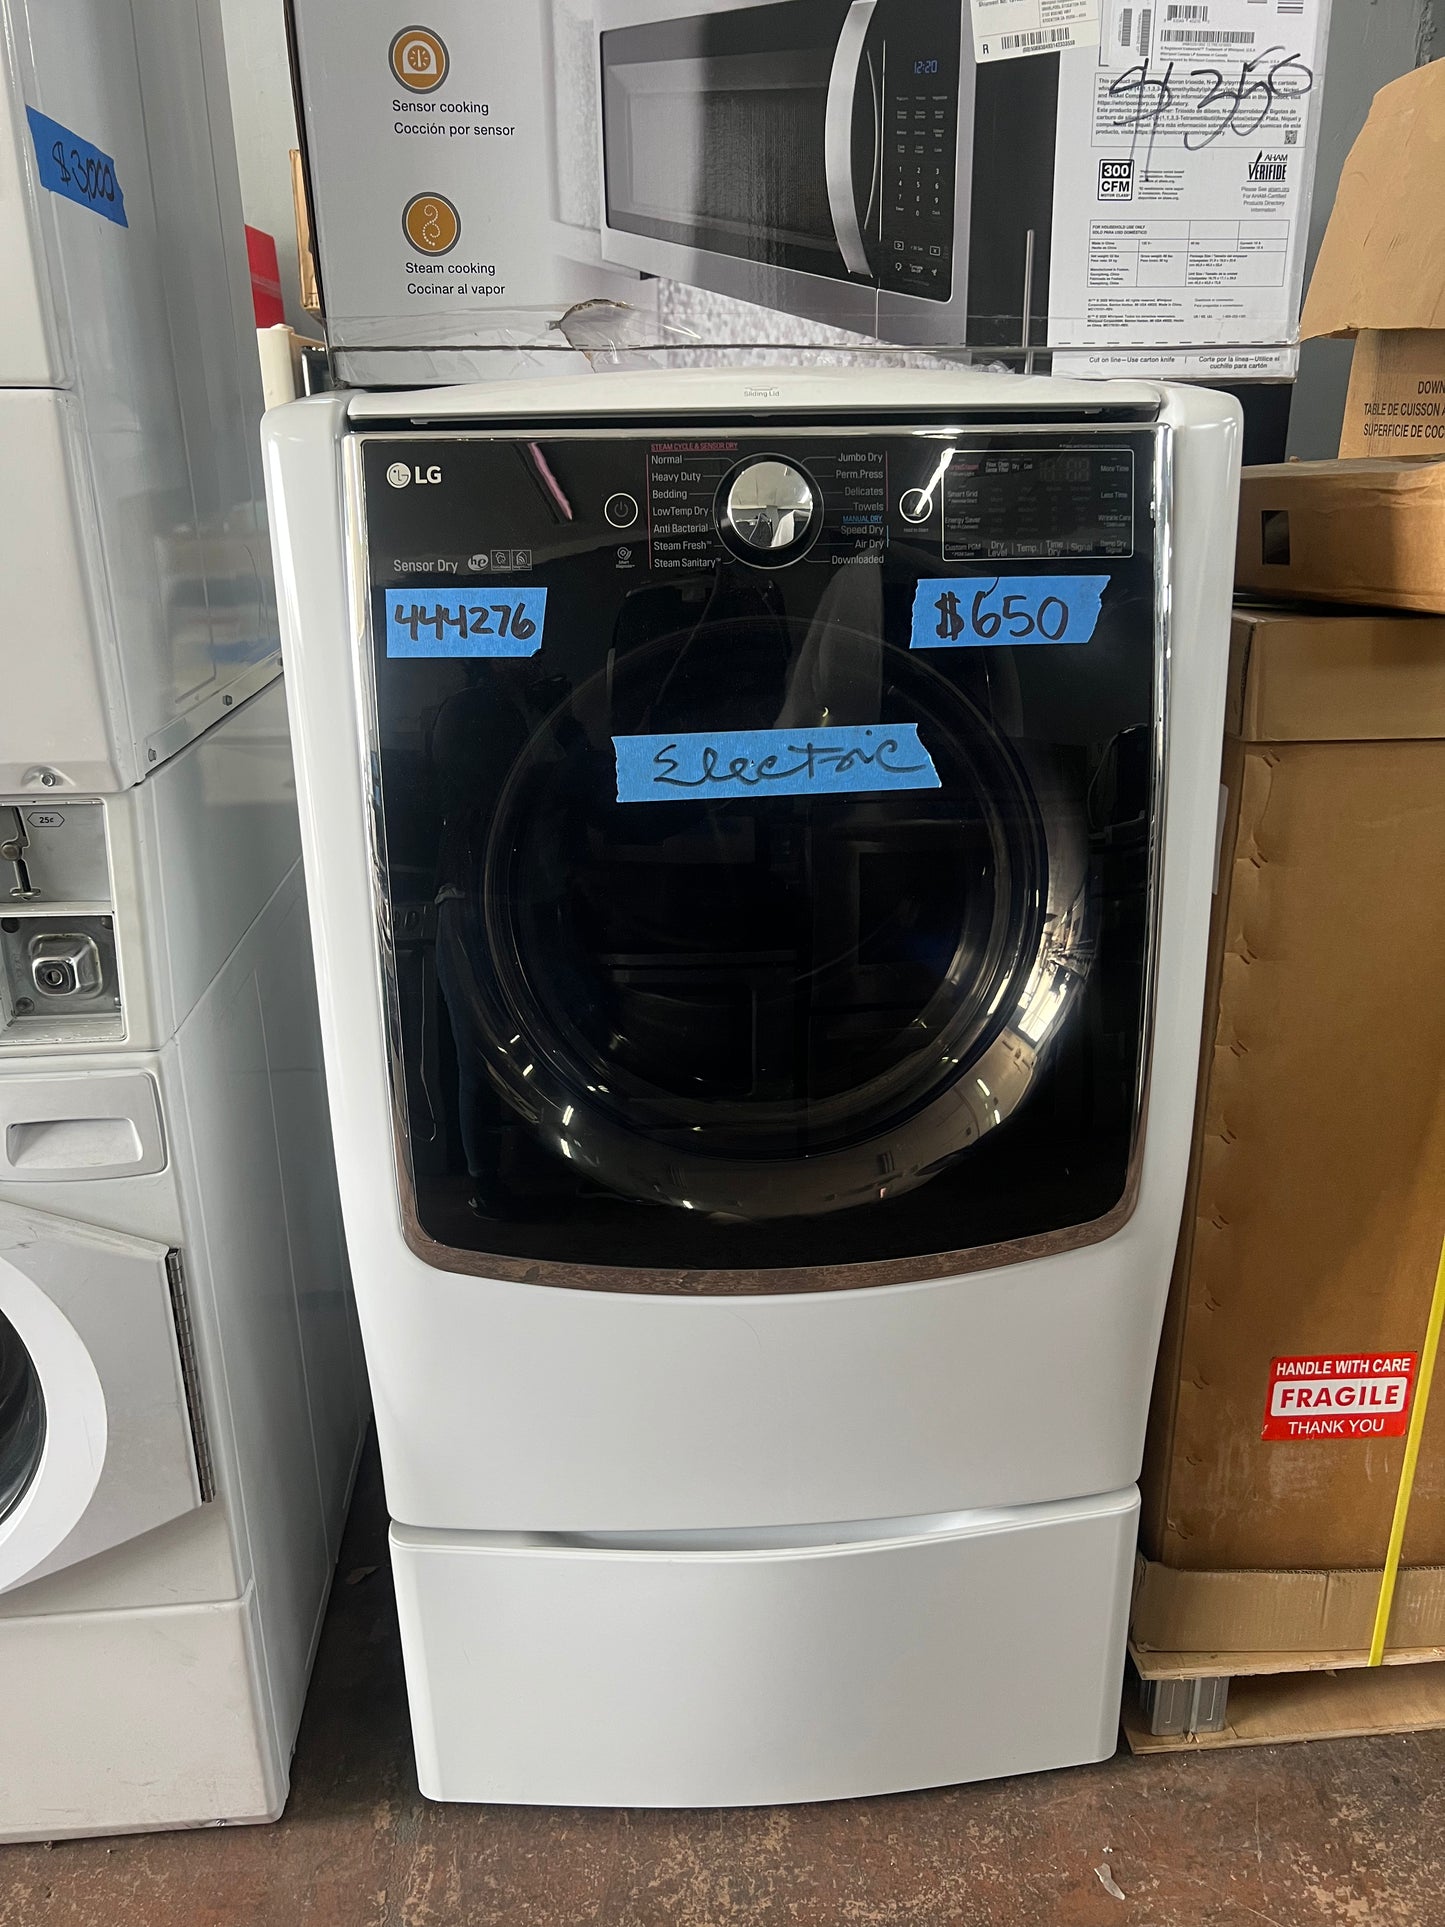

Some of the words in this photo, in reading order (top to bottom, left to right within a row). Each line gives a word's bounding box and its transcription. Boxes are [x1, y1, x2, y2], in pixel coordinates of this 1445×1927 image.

[983, 44, 989, 54] R
[914, 60, 938, 74] 12:20
[392, 99, 436, 112] Sensor
[440, 101, 489, 116] cooking
[394, 122, 446, 134] Cocción
[449, 126, 470, 137] por
[474, 126, 516, 136] sensor
[1264, 153, 1288, 161] AHAM
[1102, 164, 1130, 178] 300
[1101, 181, 1130, 193] CFM
[405, 262, 444, 274] Steam
[448, 262, 496, 277] cooking
[407, 283, 454, 294] Cocinar
[458, 283, 467, 294] al
[471, 285, 505, 297] vapor
[1364, 403, 1387, 416] TABLE
[1387, 403, 1399, 416] DE
[1400, 403, 1441, 416] CUISSON
[1364, 424, 1409, 437] SUPERFICIE
[1411, 425, 1424, 438] DE
[651, 455, 682, 464] Normal
[837, 452, 867, 462] Jumbo
[868, 452, 883, 463] Dry
[415, 465, 442, 484] LG
[651, 472, 679, 483] Heavy
[680, 472, 701, 483] Duty
[652, 489, 688, 500] Bedding
[844, 486, 884, 496] Delicates
[694, 506, 709, 517] Dry
[853, 502, 884, 512] Towels
[842, 515, 869, 523] MANUAL
[870, 515, 883, 523] DRY
[653, 524, 670, 533] Anti
[672, 523, 709, 533] Bacterial
[840, 526, 867, 536] Speed
[869, 525, 884, 536] Dry
[653, 541, 681, 551] Steam
[855, 539, 868, 549] Air
[869, 539, 885, 550] Dry
[991, 541, 1005, 549] Dry
[1046, 540, 1064, 548] Time
[1070, 542, 1093, 552] Signal
[988, 548, 1008, 557] Level
[1048, 548, 1061, 557] Dry
[654, 558, 680, 568] Steam
[831, 554, 884, 565] Downloaded
[393, 559, 435, 572] Sensor
[437, 559, 458, 574] Dry
[934, 591, 1069, 641] $650
[395, 603, 536, 641] 444276
[1276, 1360, 1333, 1376] HANDLE
[1335, 1359, 1370, 1374] WITH
[1372, 1358, 1411, 1373] CARE
[1281, 1385, 1400, 1409] FRAGILE
[1288, 1420, 1345, 1435] THANK
[1348, 1419, 1385, 1433] YOU
